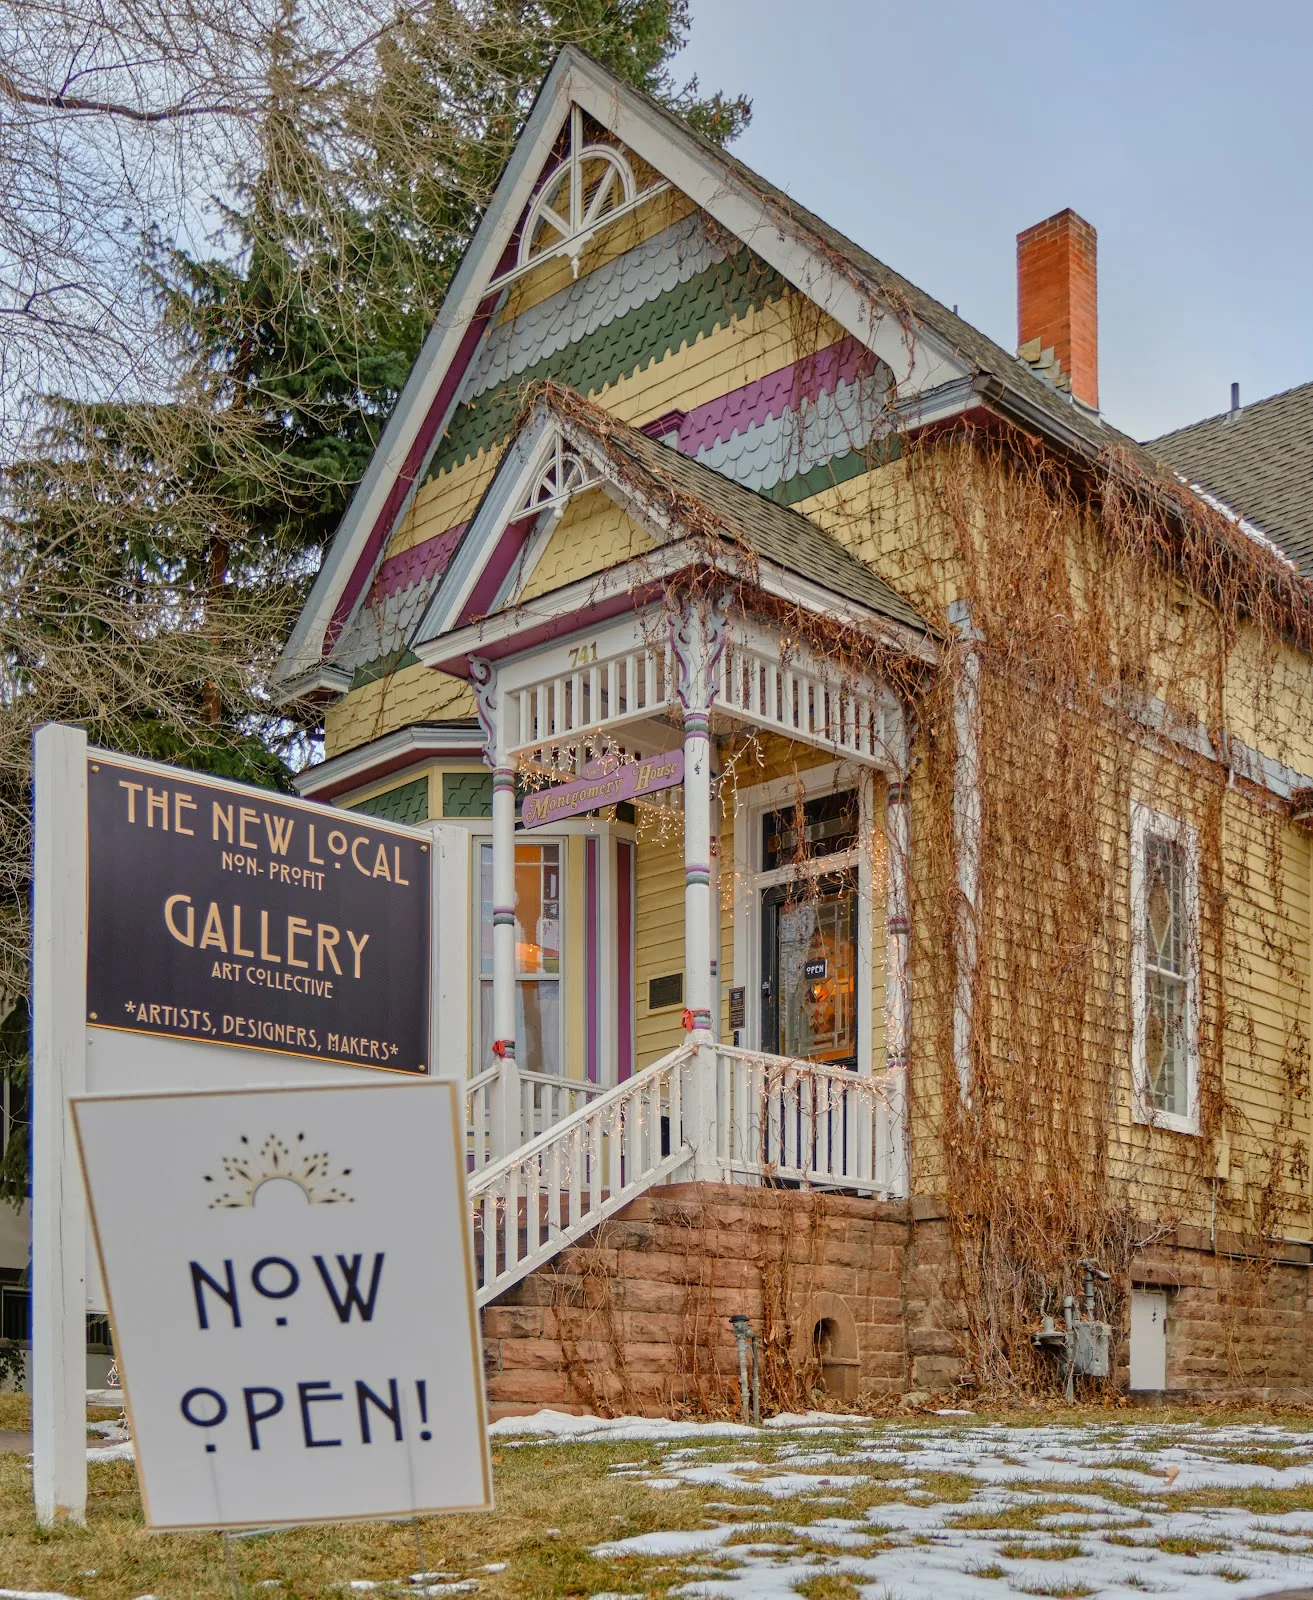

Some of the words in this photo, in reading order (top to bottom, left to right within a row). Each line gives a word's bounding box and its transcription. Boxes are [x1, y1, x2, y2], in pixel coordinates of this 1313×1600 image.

[568, 641, 598, 668] 741
[525, 779, 623, 823] Montgomery
[632, 761, 677, 791] House
[119, 780, 197, 836] THE
[212, 801, 294, 856] NEW
[308, 823, 410, 886] LOCAL
[164, 894, 370, 979] GALLERY
[211, 961, 242, 982] ART
[246, 966, 334, 999] COLLECTIVE
[806, 965, 824, 975] OPEN
[222, 1014, 321, 1052] DESIGNERS,
[188, 1252, 385, 1330] NOW
[180, 1378, 433, 1453] OPEN!
